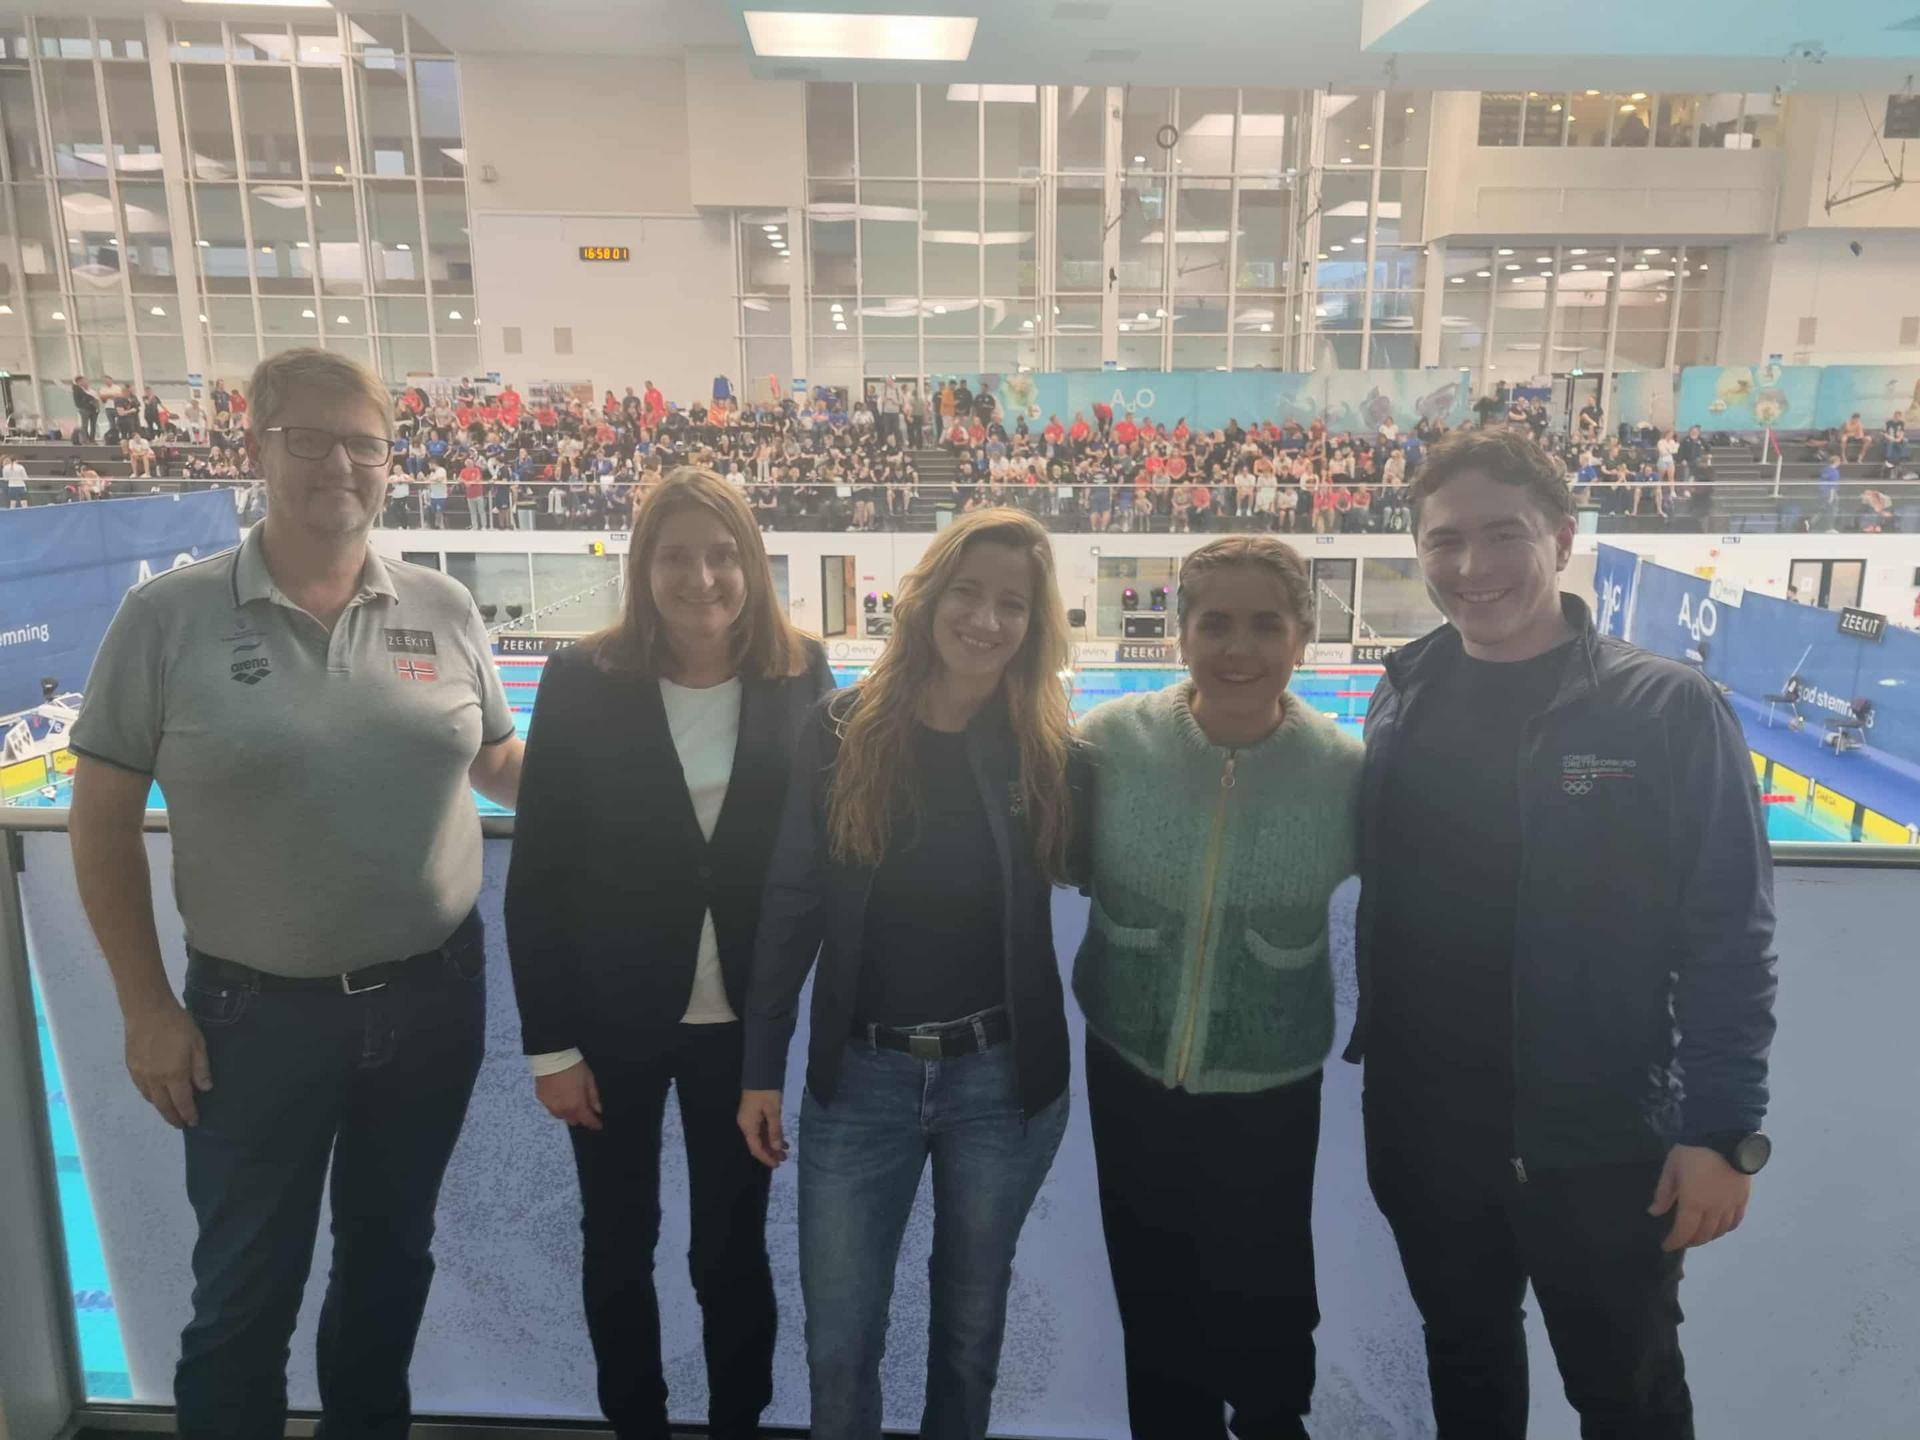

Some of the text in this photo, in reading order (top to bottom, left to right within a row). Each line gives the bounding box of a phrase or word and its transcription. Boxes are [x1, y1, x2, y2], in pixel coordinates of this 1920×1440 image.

[1678, 592, 1718, 641] AdO
[1841, 612, 1880, 634] ZEEKIT
[388, 636, 431, 648] ZEEKIT
[502, 639, 545, 651] ZEEKIT
[1122, 646, 1167, 659] ZEEKIT
[230, 657, 269, 673] arena
